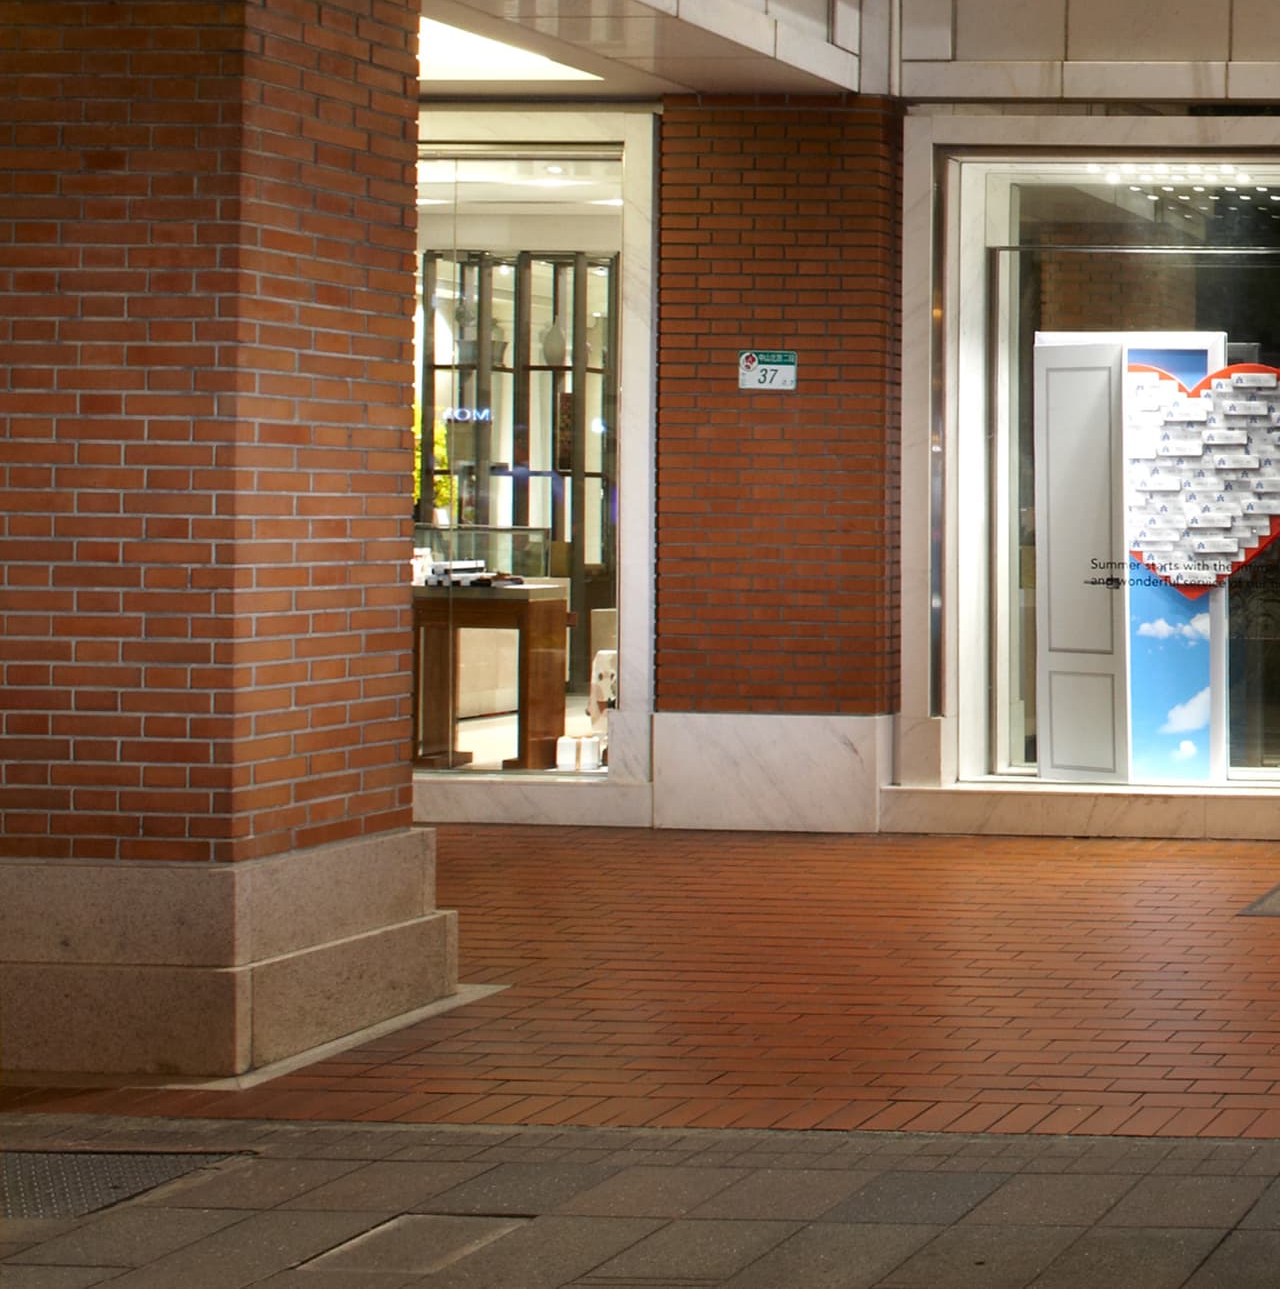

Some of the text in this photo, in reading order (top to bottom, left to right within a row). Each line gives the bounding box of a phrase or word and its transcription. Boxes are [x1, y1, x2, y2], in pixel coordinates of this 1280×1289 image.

[758, 368, 778, 384] 37
[1090, 558, 1140, 570] Summer
[1144, 560, 1180, 571] starts
[1184, 560, 1210, 571] with
[1213, 560, 1232, 572] the
[1090, 574, 1113, 586] and
[1117, 575, 1178, 587] wonderful
